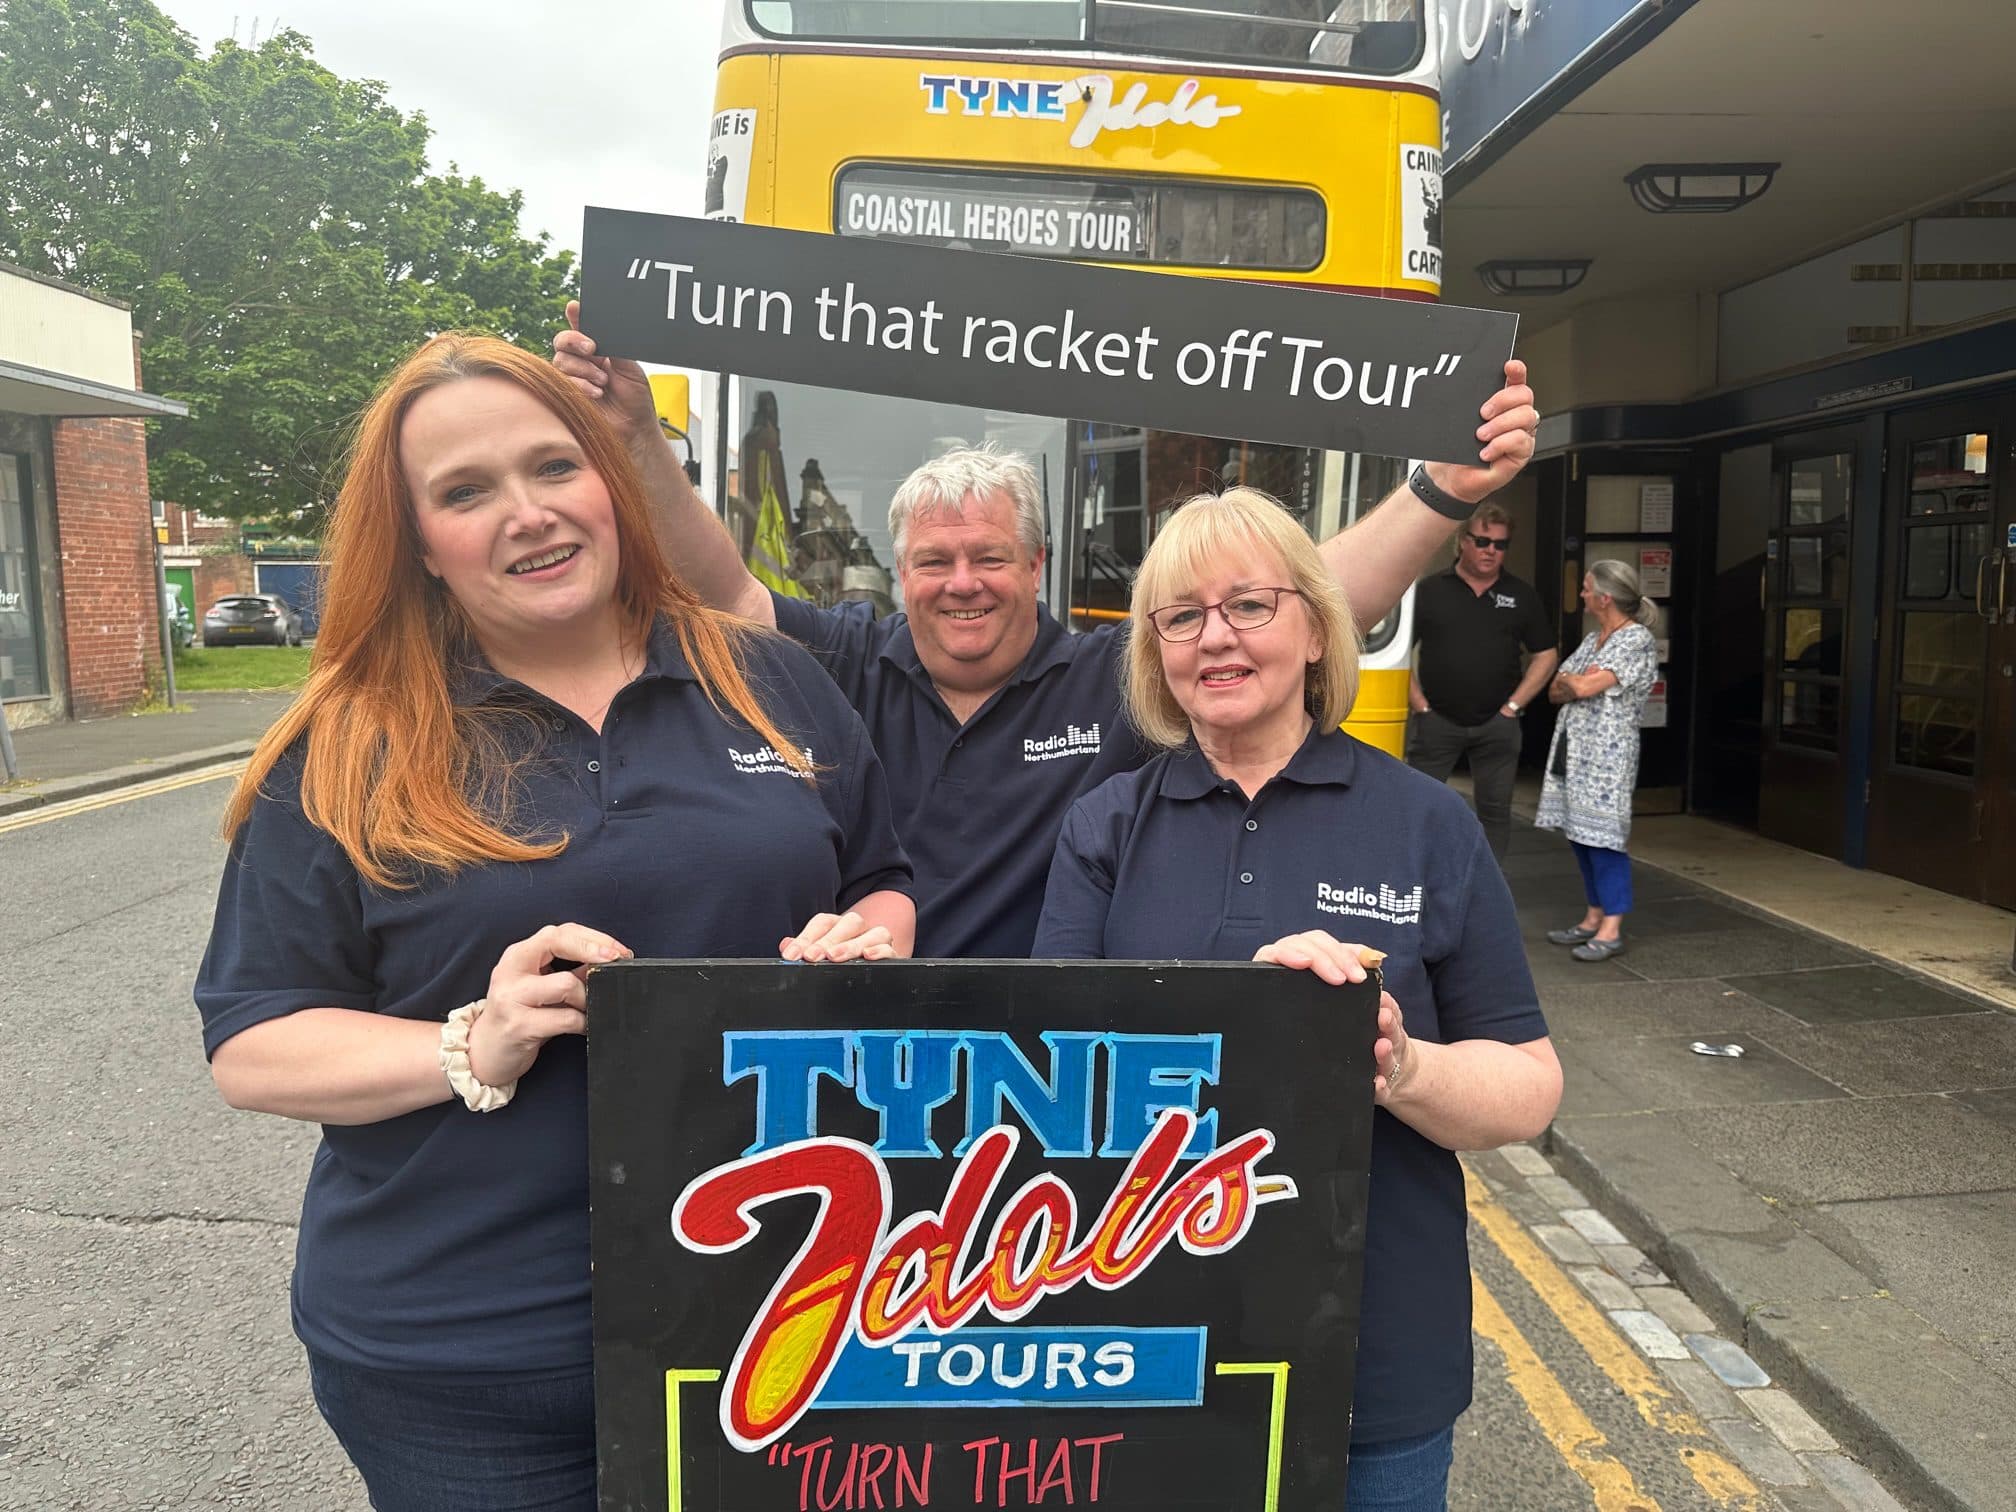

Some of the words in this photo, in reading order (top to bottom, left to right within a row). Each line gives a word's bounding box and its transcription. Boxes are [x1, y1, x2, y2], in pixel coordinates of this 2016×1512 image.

[734, 113, 750, 136] is
[920, 73, 1065, 121] TYNE
[1059, 74, 1242, 148] Idols
[848, 193, 955, 238] COASTAL
[963, 203, 1060, 247] HEROES
[1067, 211, 1132, 252] TOUR
[627, 258, 793, 335] “Turn
[815, 282, 943, 355] that
[962, 309, 1159, 381] racket
[1176, 329, 1273, 392] off
[1281, 337, 1462, 409] Tour”
[728, 746, 785, 765] Radio
[1024, 735, 1067, 752] Radio
[1024, 745, 1101, 762] Northumberland
[1316, 900, 1419, 925] Northumberland
[1317, 882, 1378, 906] Radio
[722, 1030, 1223, 1159] TYNE
[671, 1107, 1299, 1452] Idols
[892, 1340, 1135, 1390] TOURS
[963, 1432, 1125, 1508] THAT
